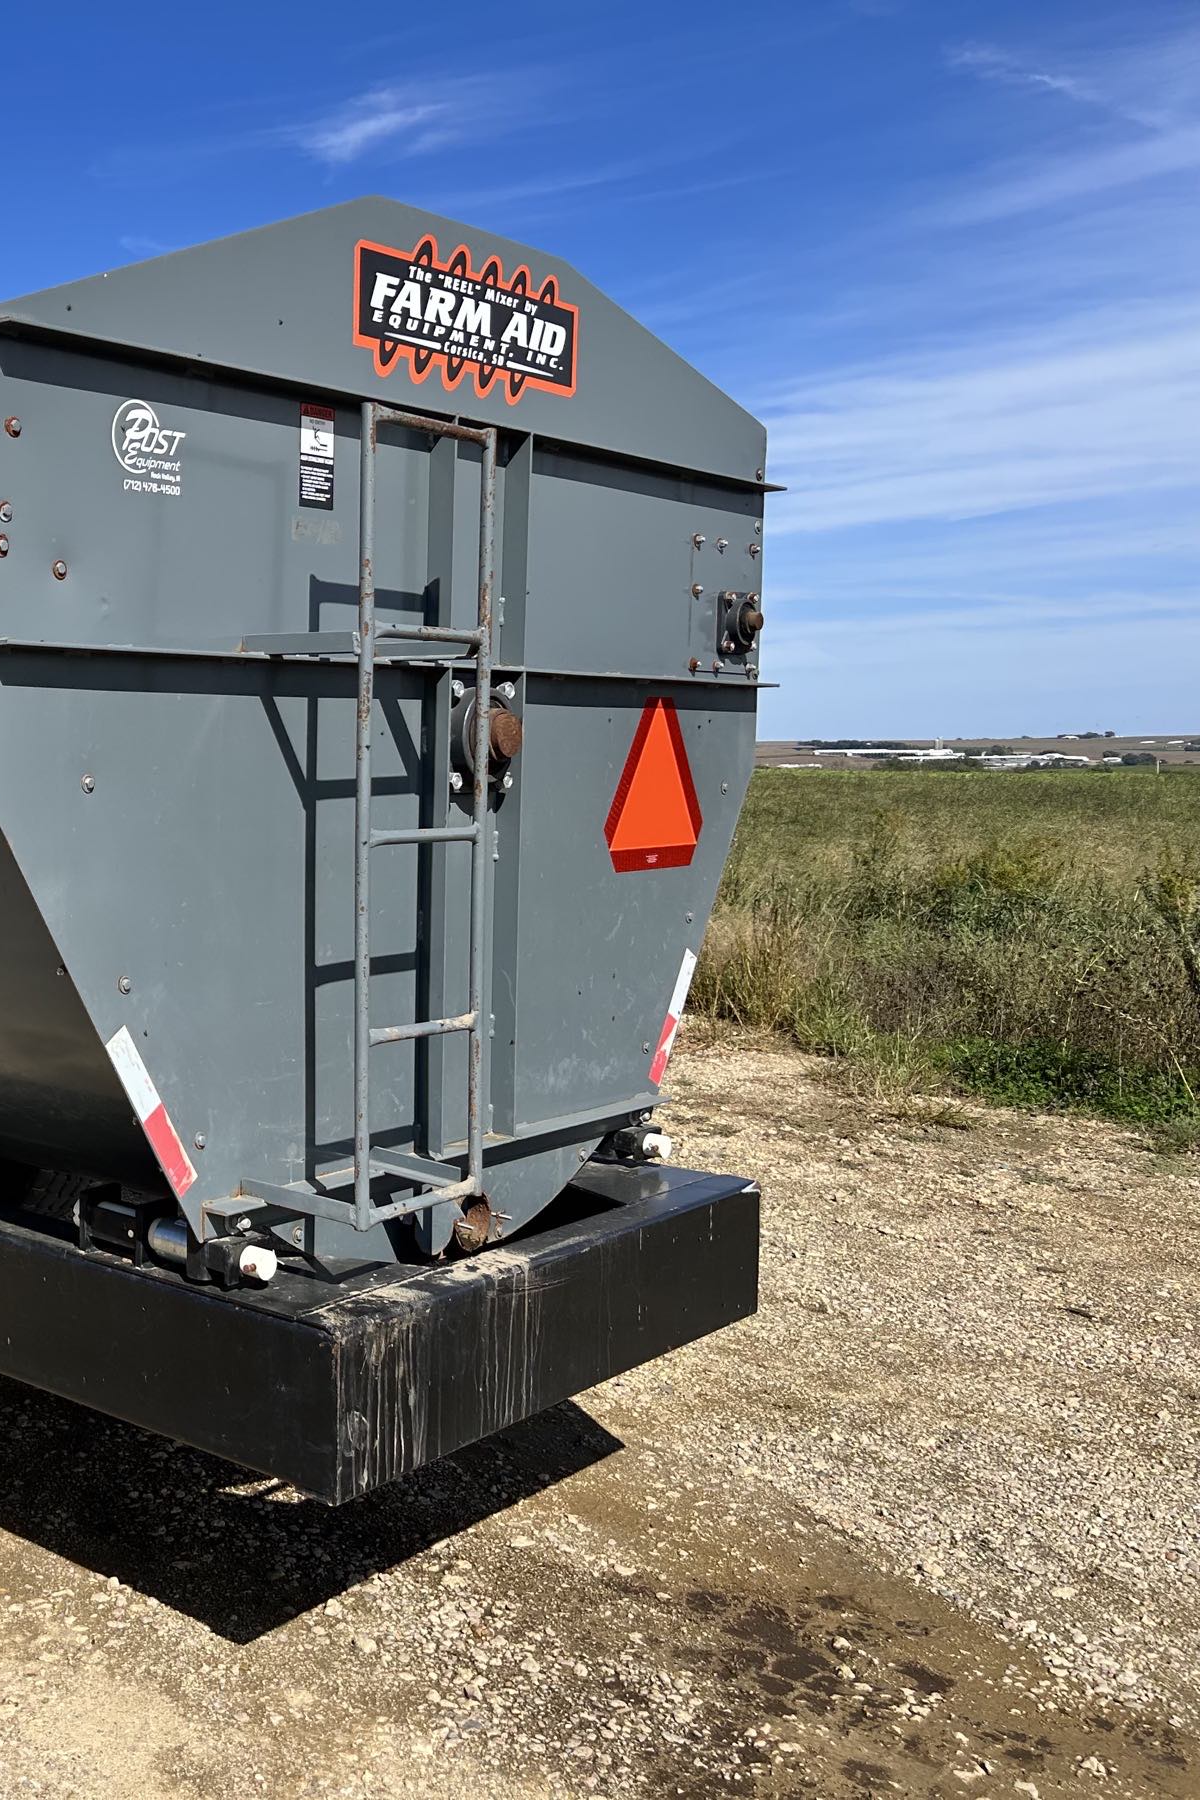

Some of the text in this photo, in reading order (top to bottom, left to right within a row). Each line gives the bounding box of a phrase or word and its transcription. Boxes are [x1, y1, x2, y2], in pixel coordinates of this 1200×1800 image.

[408, 265, 432, 284] The
[485, 288, 519, 309] Mixer
[524, 300, 538, 316] by
[370, 272, 567, 358] FARM AID
[492, 354, 504, 366] SD
[526, 349, 564, 371] INC.
[124, 442, 180, 471] Equipment
[124, 479, 141, 492] (712)
